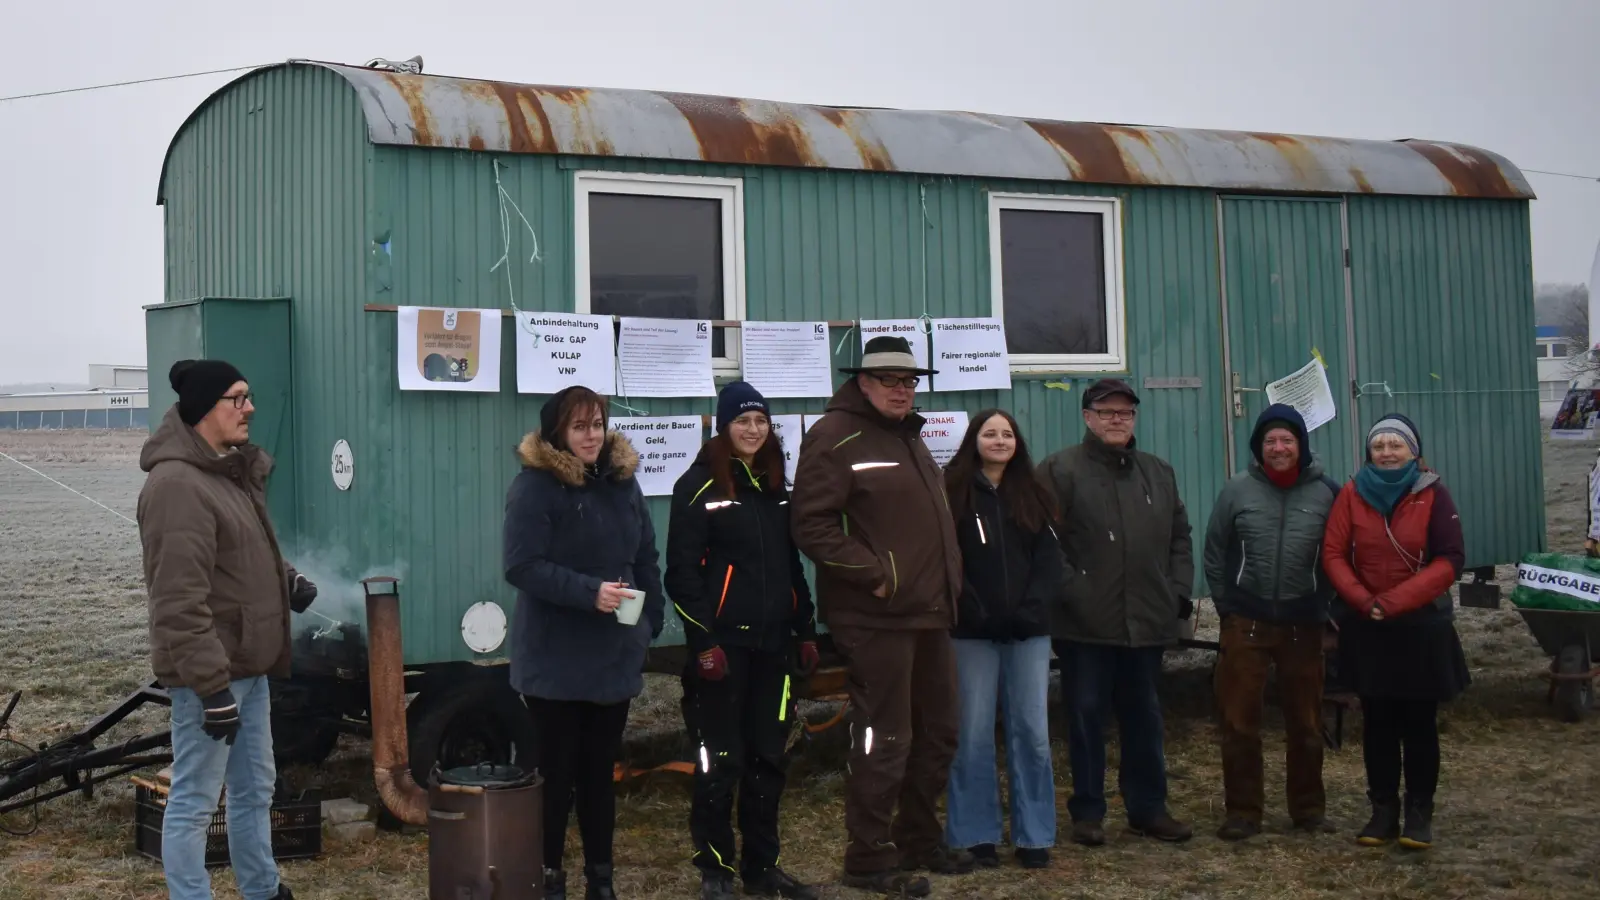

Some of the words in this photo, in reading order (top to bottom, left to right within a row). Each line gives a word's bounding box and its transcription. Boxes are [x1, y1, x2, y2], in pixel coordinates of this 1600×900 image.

[530, 318, 599, 330] Anbindehaltung
[696, 322, 707, 332] IG
[814, 324, 824, 334] IG
[964, 352, 1001, 360] regionaler
[110, 396, 128, 404] H+H
[646, 437, 666, 445] Geld,
[662, 452, 686, 460] ganze
[335, 454, 344, 474] 25
[1518, 568, 1600, 595] RÜCKGABE
